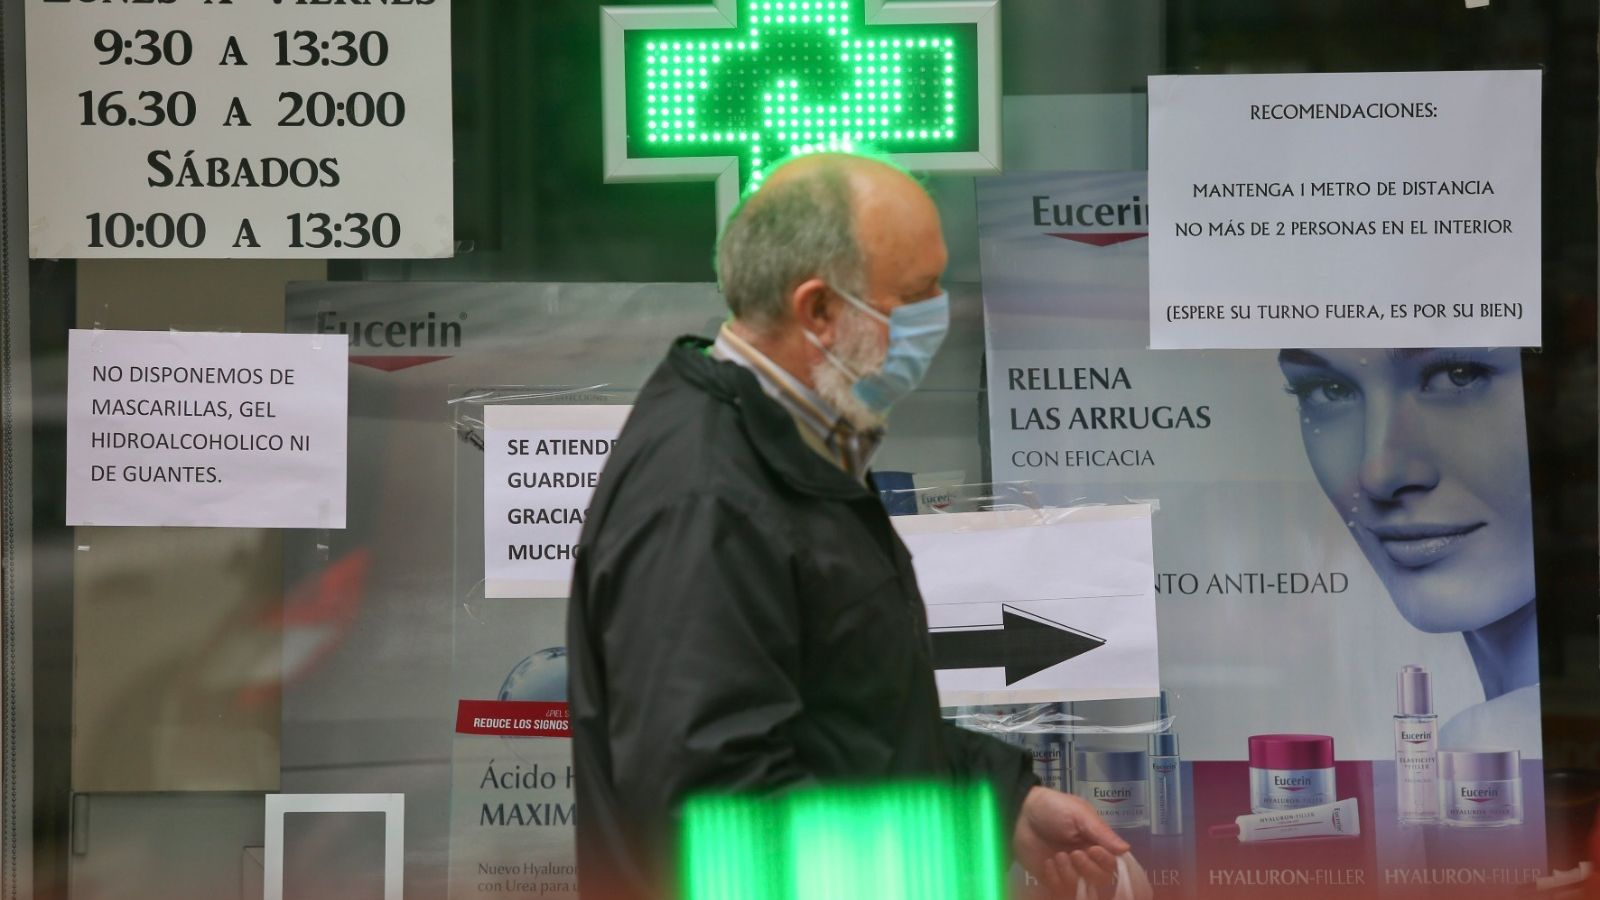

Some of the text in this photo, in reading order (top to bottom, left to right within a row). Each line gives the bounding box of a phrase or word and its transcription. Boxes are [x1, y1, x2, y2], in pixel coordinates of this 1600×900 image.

[94, 29, 389, 67] 9:30 A 13:30
[79, 90, 405, 127] 16.30 A 20:00
[1250, 103, 1438, 120] RECOMENDACIONES:
[147, 150, 341, 188] SÁBADOS
[1193, 180, 1495, 198] MANTENGA 1 METRO DE DISTANCIA
[1032, 195, 1149, 226] Euceri
[85, 212, 401, 248] 10:00 A 13:30
[1175, 219, 1513, 237] NO MÁS DE 2 PERSONAS EN EL INTERIOR
[1166, 303, 1523, 323] (ESPERE SU TURNO FUERA, ES POR SU BIEN)
[93, 366, 295, 385] NO DISPONEMOS DE
[1008, 367, 1132, 390] RELLENA
[92, 399, 276, 420] MASCARILLAS, GEL
[1010, 405, 1211, 430] LAS ARRUGAS
[92, 431, 310, 451] HIDROALCOHOLICO NI
[507, 439, 529, 455] SE
[1012, 449, 1155, 467] CON EFICACIA
[91, 465, 222, 483] DE GUANTES.
[1206, 572, 1349, 594] ANTI-EDAD
[473, 717, 569, 730] REDUCE LOS SIGNOS
[480, 759, 556, 789] Ácido
[1274, 776, 1311, 786] Eucerin
[1094, 787, 1131, 798] Eucerin
[1461, 787, 1498, 797] Eucerin
[480, 803, 577, 826] MAXIM
[477, 863, 521, 875] Nuevo
[1209, 868, 1366, 886] HYALURON-FILLER
[478, 882, 502, 892] con
[505, 880, 537, 892] Urea
[541, 882, 569, 896] para
